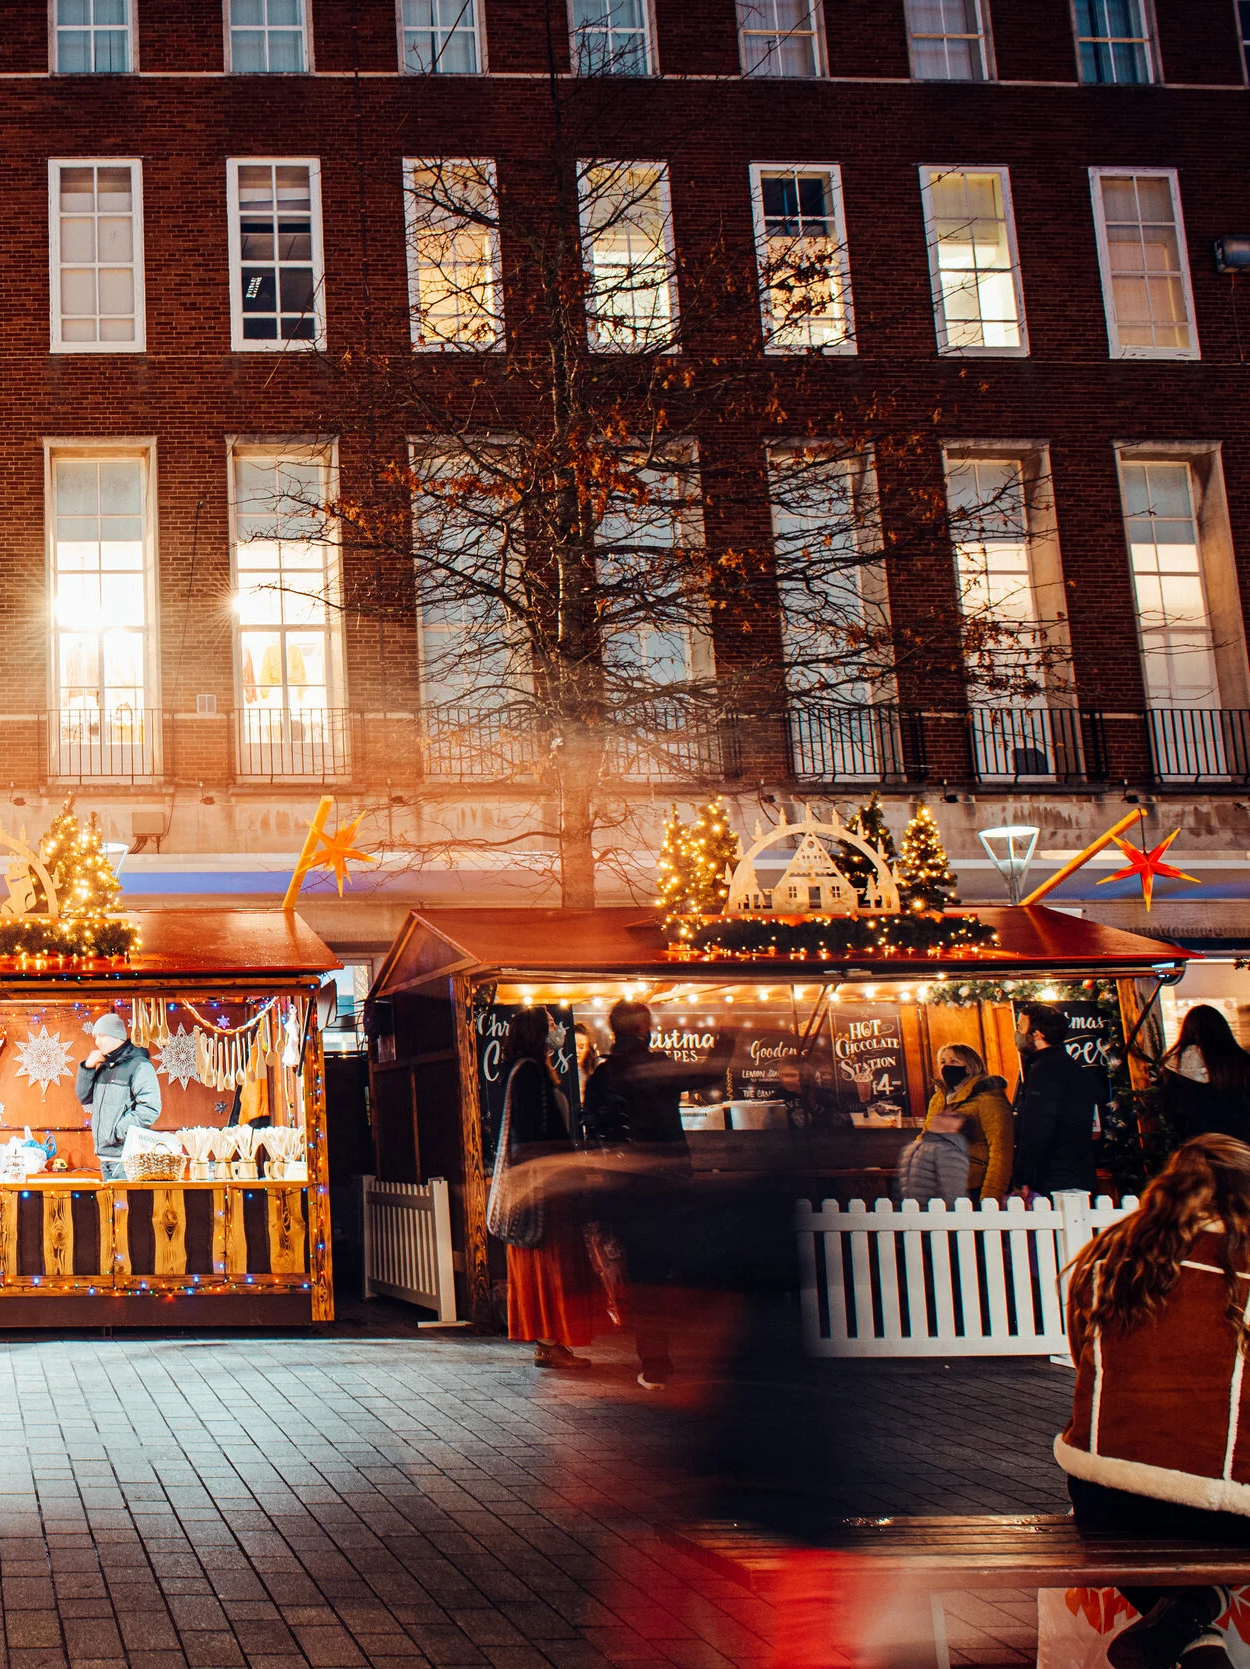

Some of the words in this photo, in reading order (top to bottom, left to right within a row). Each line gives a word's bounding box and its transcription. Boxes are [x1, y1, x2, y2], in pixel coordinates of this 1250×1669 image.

[849, 1019, 882, 1040] HOT
[835, 1038, 900, 1059] CHOCOLATE
[840, 1056, 897, 1081] STATION
